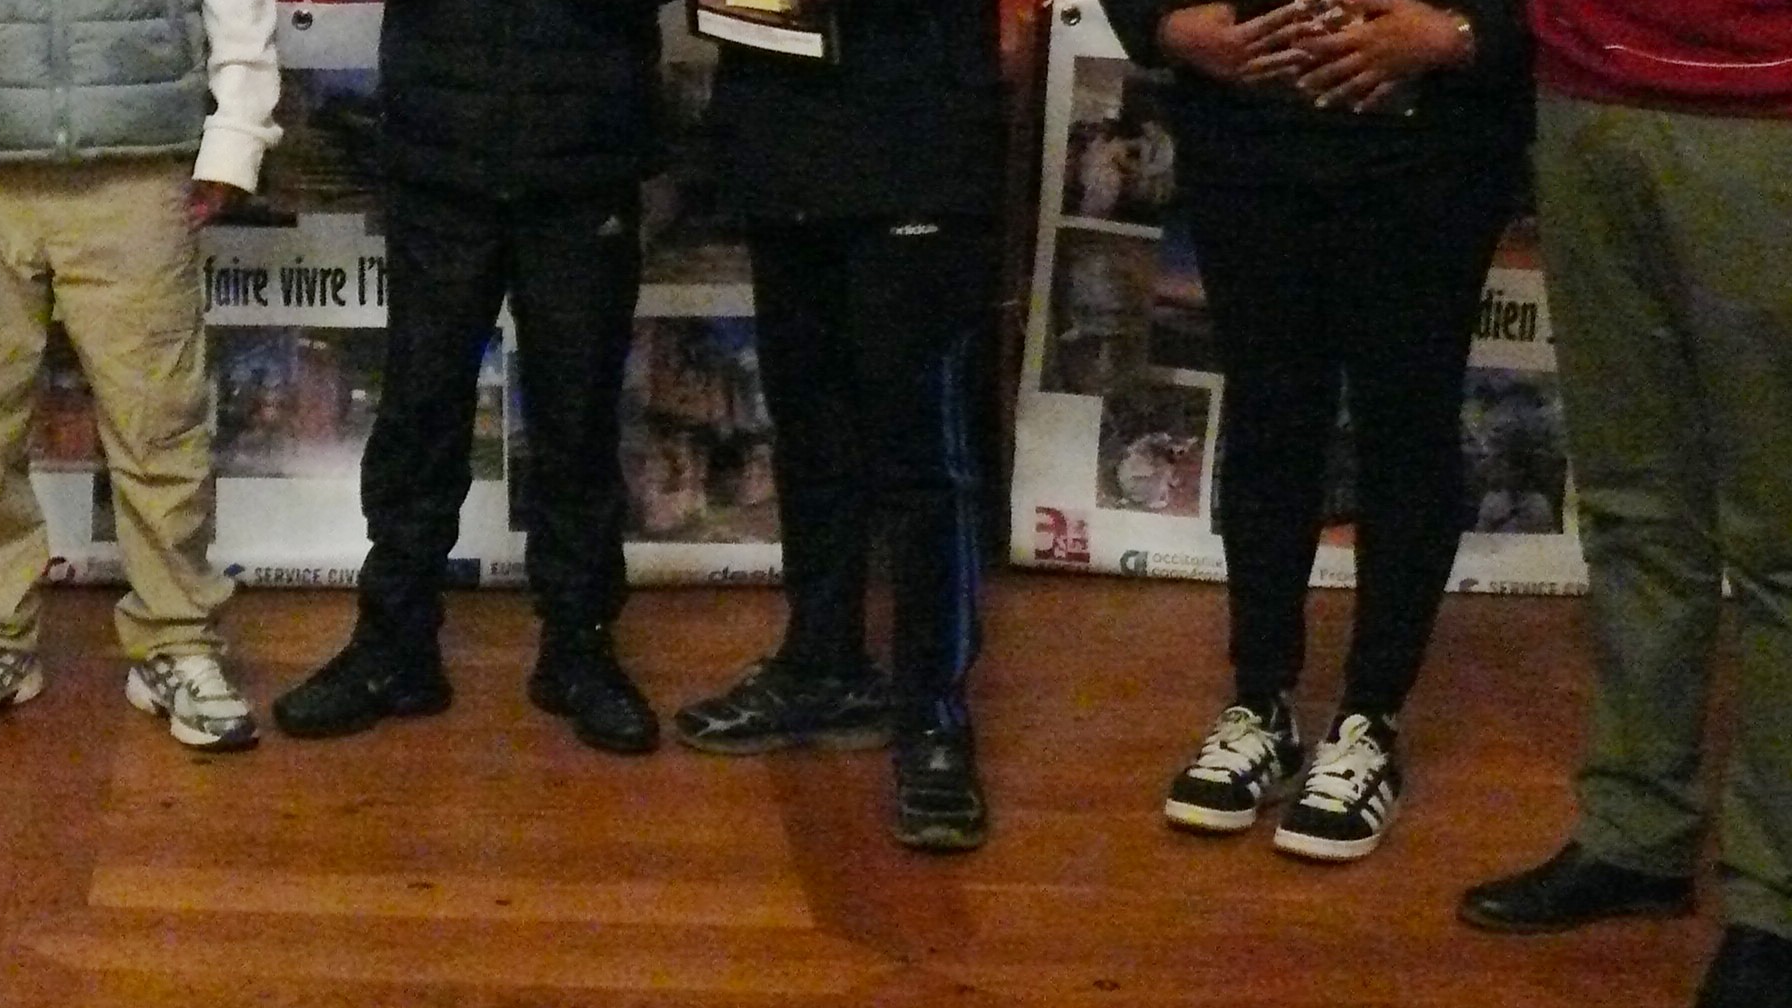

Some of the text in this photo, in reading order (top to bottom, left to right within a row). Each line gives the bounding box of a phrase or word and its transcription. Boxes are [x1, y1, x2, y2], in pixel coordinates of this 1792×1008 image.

[203, 255, 386, 313] faire vivre l'h
[1479, 288, 1537, 342] dien
[254, 567, 322, 584] SERVICE
